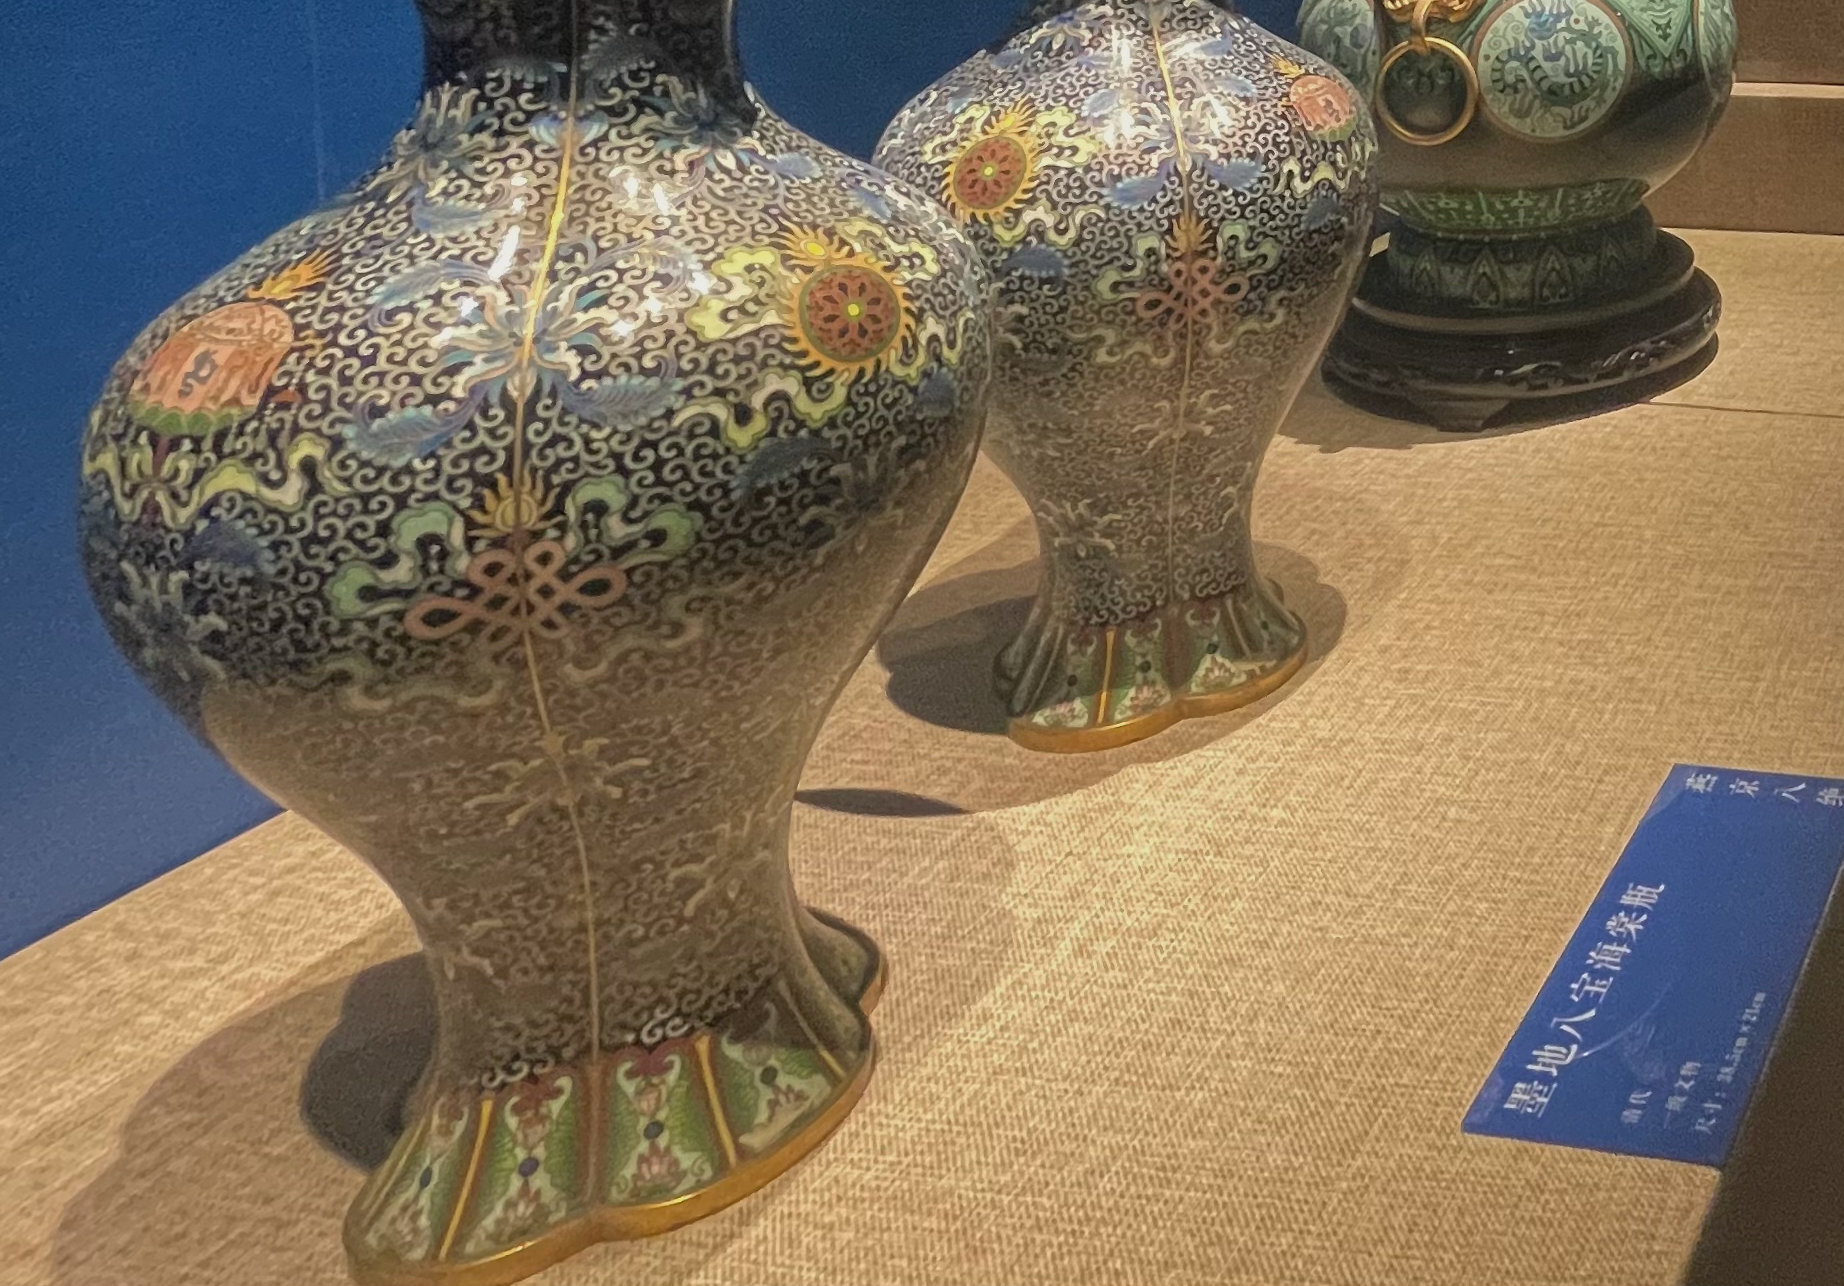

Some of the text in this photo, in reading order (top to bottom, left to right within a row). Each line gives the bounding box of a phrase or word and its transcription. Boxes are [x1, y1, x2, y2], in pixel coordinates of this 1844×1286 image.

[1502, 882, 1666, 1120] 墨地八宝海棠瓶
